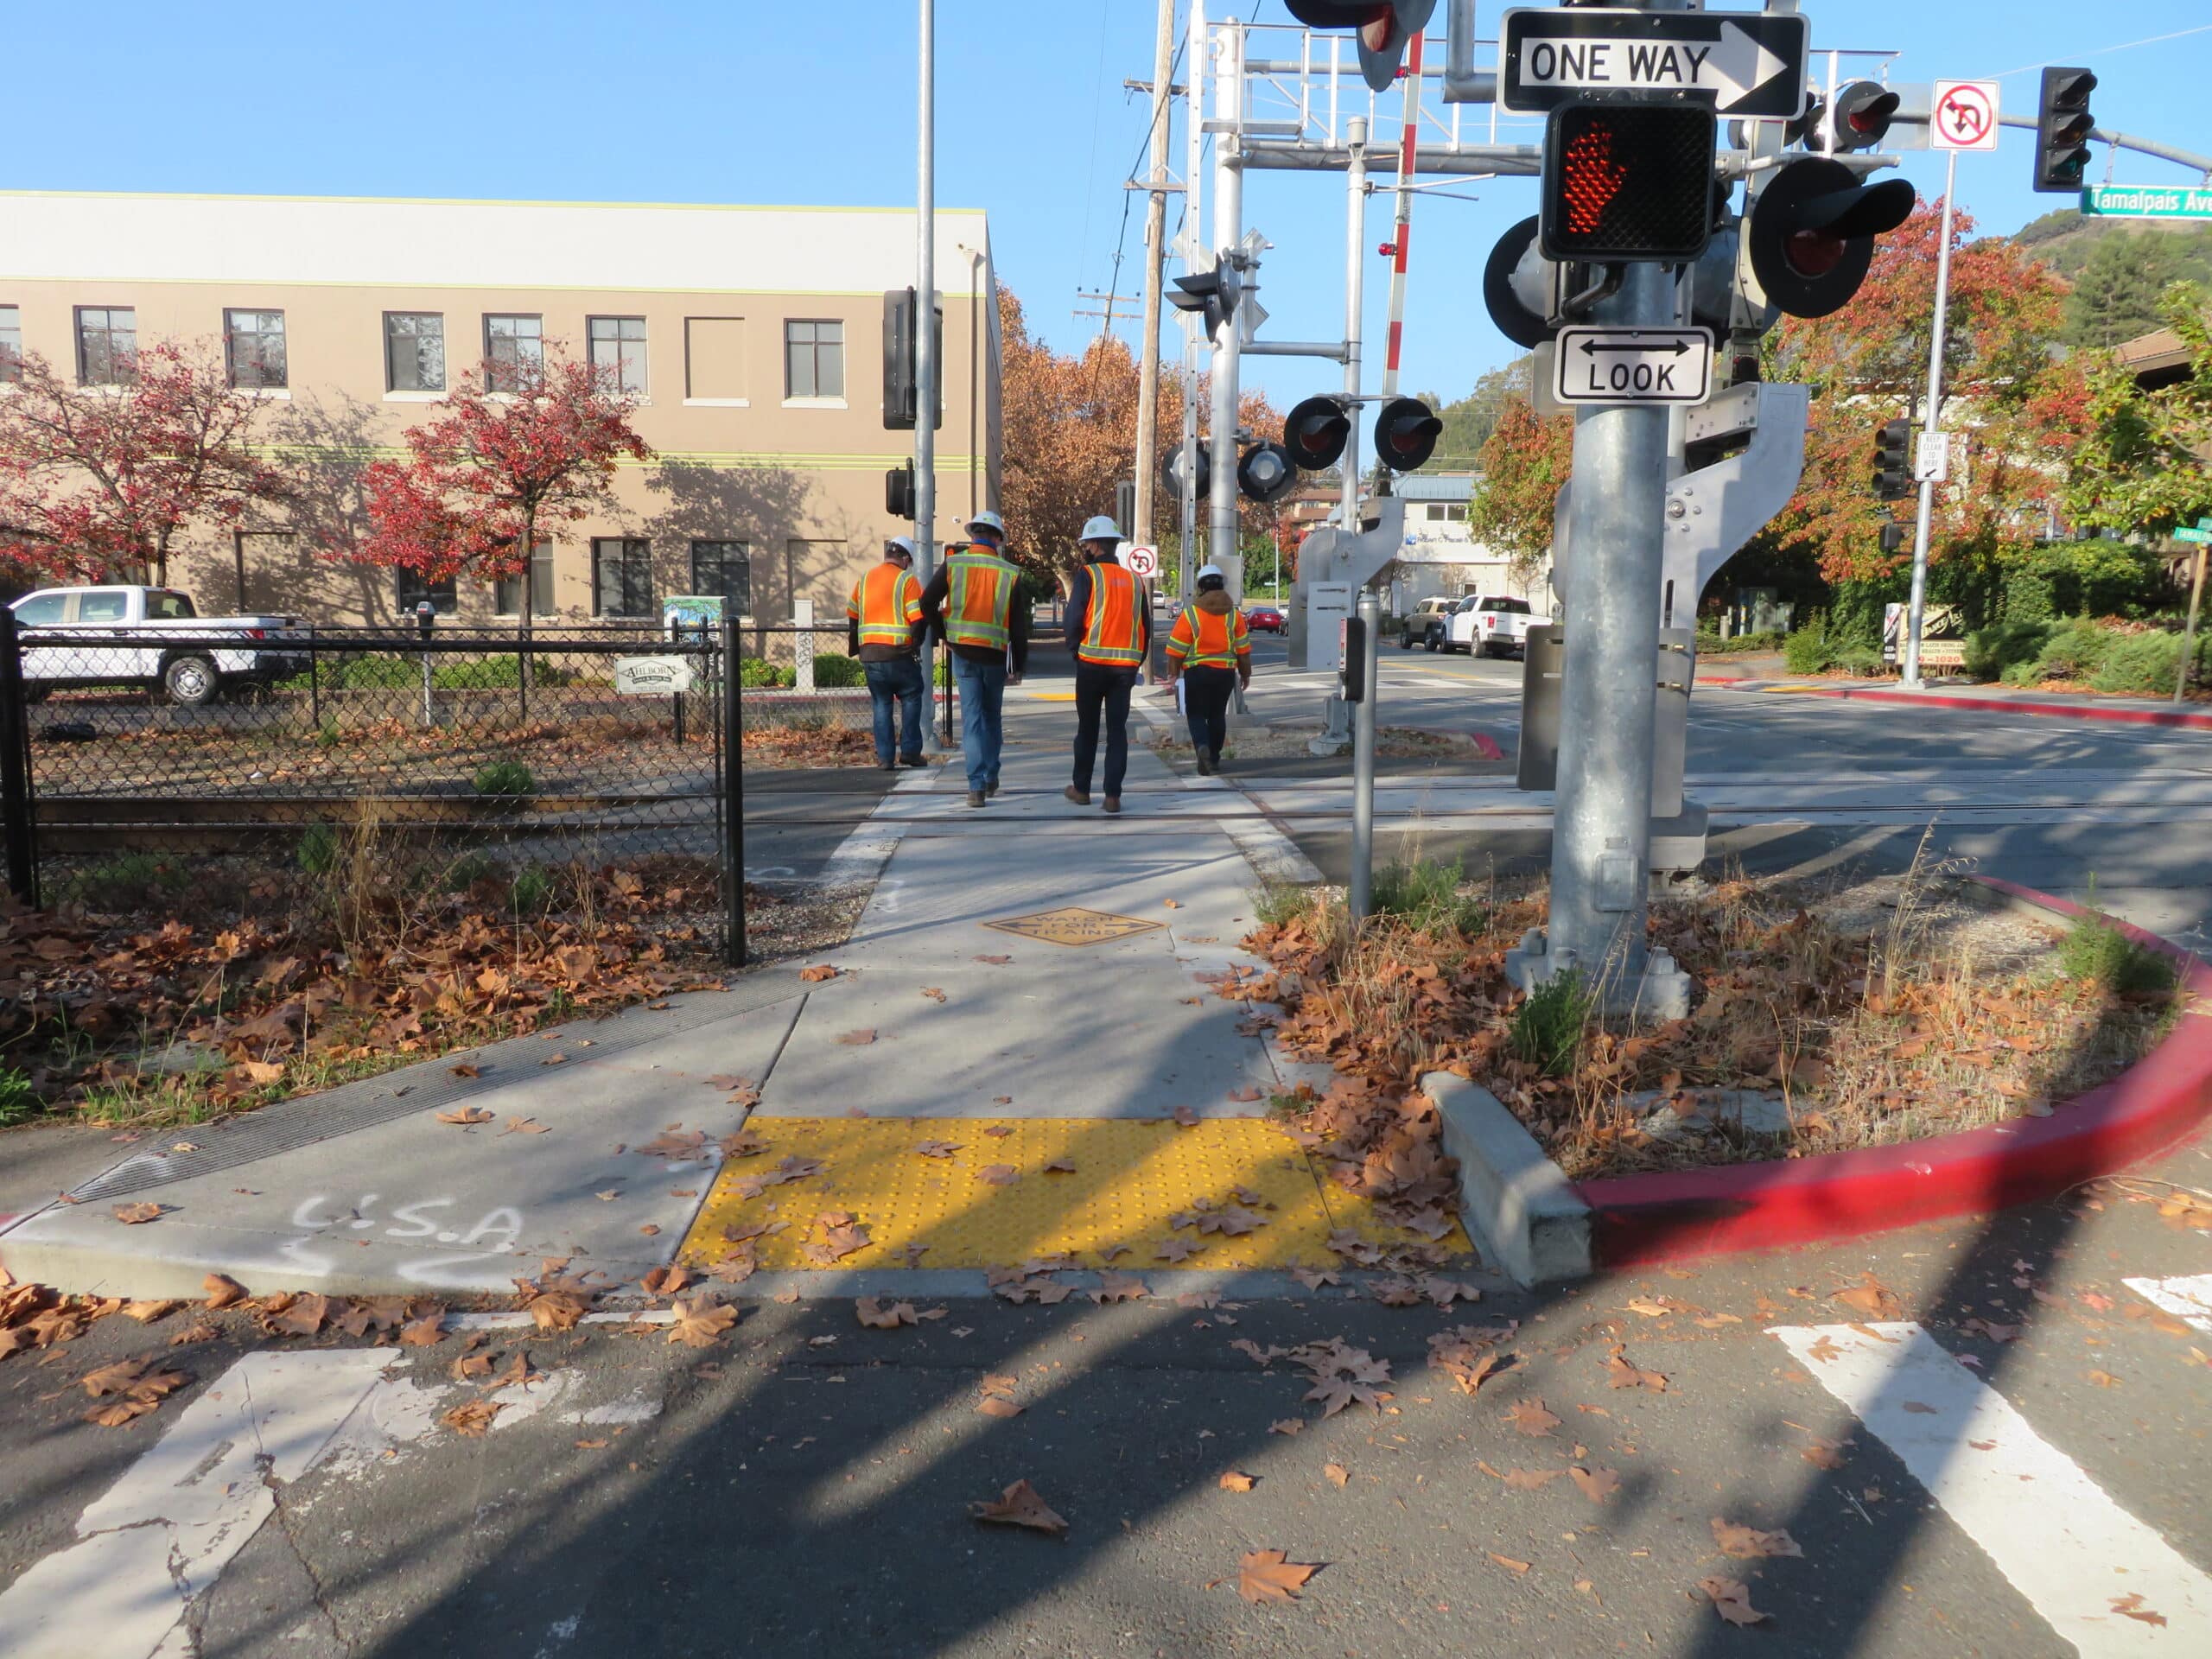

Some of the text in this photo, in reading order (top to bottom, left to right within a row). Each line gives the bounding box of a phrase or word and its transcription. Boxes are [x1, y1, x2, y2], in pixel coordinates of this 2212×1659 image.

[1530, 42, 1712, 84] ONE WAY
[2092, 188, 2180, 214] Tamalpais
[1589, 363, 1675, 391] LOOK
[626, 665, 677, 677] AHLBORN
